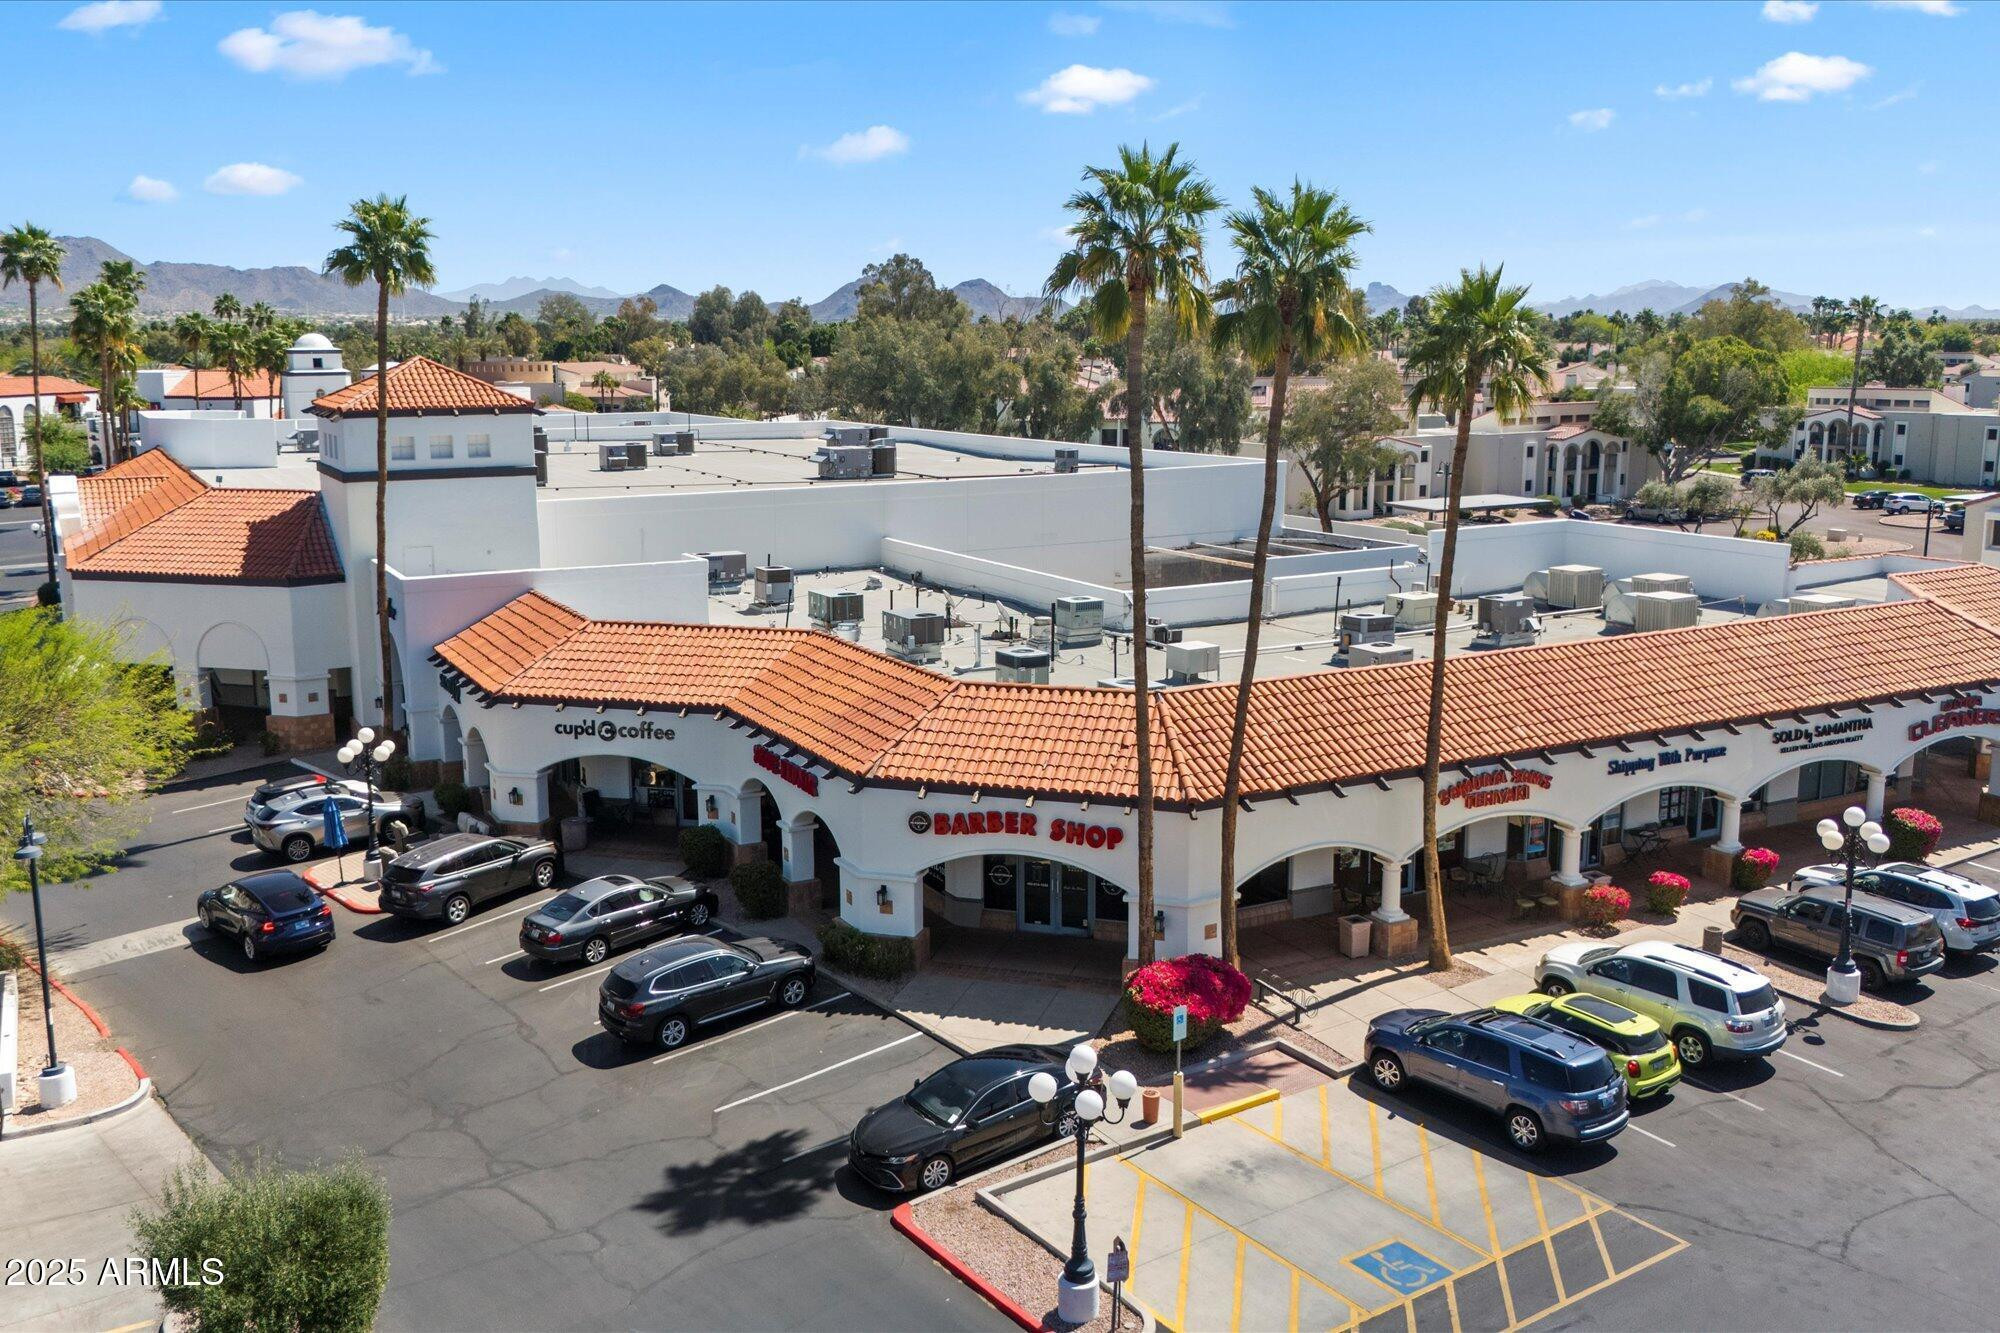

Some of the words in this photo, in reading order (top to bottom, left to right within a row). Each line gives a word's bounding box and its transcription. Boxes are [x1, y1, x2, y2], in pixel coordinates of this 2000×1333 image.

[555, 719, 596, 739] cup'd
[618, 720, 675, 740] coffee
[1772, 728, 1803, 744] SOLD
[1803, 729, 1813, 743] by
[1814, 717, 1873, 738] SAMANTHA
[1908, 708, 2000, 741] CLEANER
[1607, 757, 1656, 776] Shipping
[1658, 749, 1682, 766] With
[1685, 745, 1727, 763] Purpose
[1464, 784, 1529, 809] TERIYAKI
[933, 811, 1037, 836] BARBER
[1049, 818, 1124, 850] SHOP
